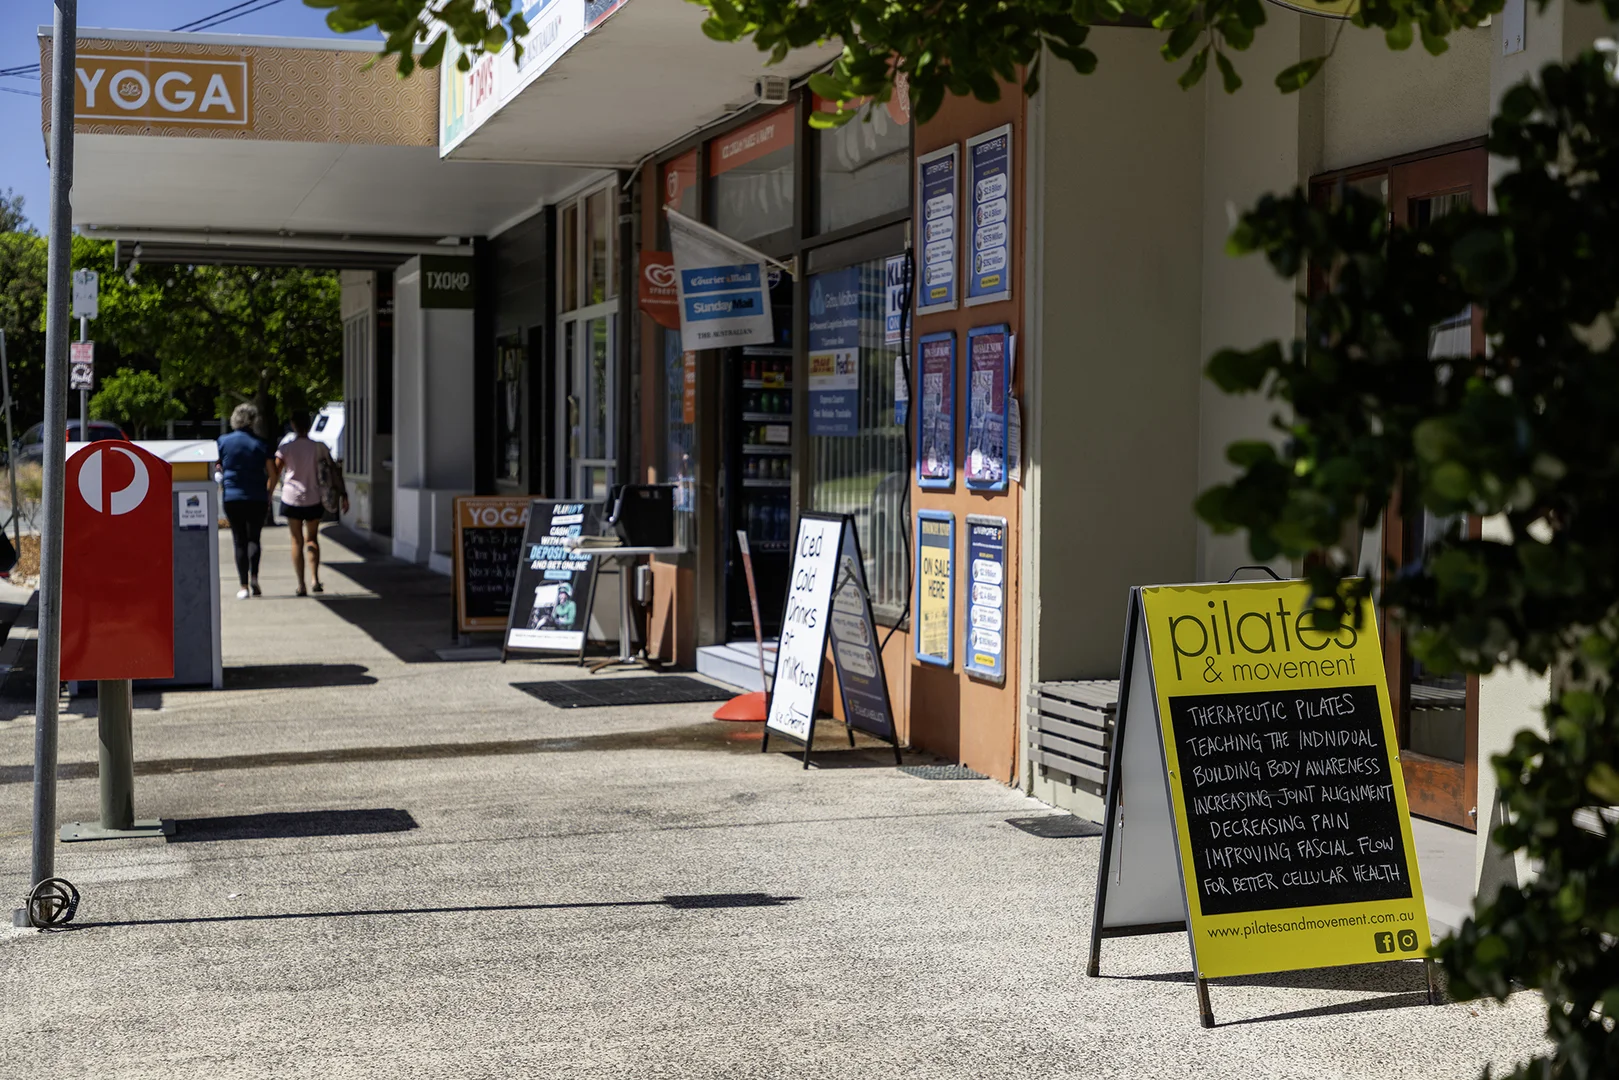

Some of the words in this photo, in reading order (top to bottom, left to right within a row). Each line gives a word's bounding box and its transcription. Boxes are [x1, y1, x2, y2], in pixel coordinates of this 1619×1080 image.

[75, 68, 236, 113] YOGA
[690, 276, 725, 287] Courier
[697, 331, 711, 340] THE
[713, 327, 753, 338] AUSTRALIAN
[468, 508, 530, 527] YOGA
[530, 545, 568, 560] DEPOSIT
[541, 536, 560, 545] WITH
[799, 524, 825, 558] Iced
[531, 560, 547, 570] AND
[562, 561, 588, 571] ONLINE
[923, 557, 934, 575] ON
[934, 558, 950, 578] SALE
[796, 566, 818, 592] Cold
[928, 579, 946, 600] HERE
[1169, 598, 1357, 680] pilates
[1203, 656, 1223, 682] &
[1232, 654, 1355, 681] movement
[1186, 701, 1287, 726] THERAPEUTIC
[1296, 693, 1355, 720] PILATES
[1186, 733, 1263, 756] TEACHING
[1264, 731, 1290, 748] THE
[1193, 760, 1261, 787] BUILDING
[1267, 760, 1300, 778] BODY
[1305, 757, 1380, 776] AWARENESS
[1194, 789, 1273, 815] INCREASING
[1278, 785, 1316, 806] JOINT
[1321, 785, 1393, 803] ALIGNMENT
[1210, 815, 1305, 839] DECREASING
[1311, 813, 1349, 832] PAIN
[1205, 843, 1291, 869] IMPROVING
[1297, 838, 1353, 858] FASCIAL
[1357, 837, 1394, 854] FLOW
[1204, 878, 1231, 896] FOR
[1233, 874, 1279, 892] BETTER
[1282, 866, 1348, 886] CELLULAR
[1353, 864, 1400, 882] HEALTH
[1207, 911, 1415, 939] www.pilatesandmovement.com.au
